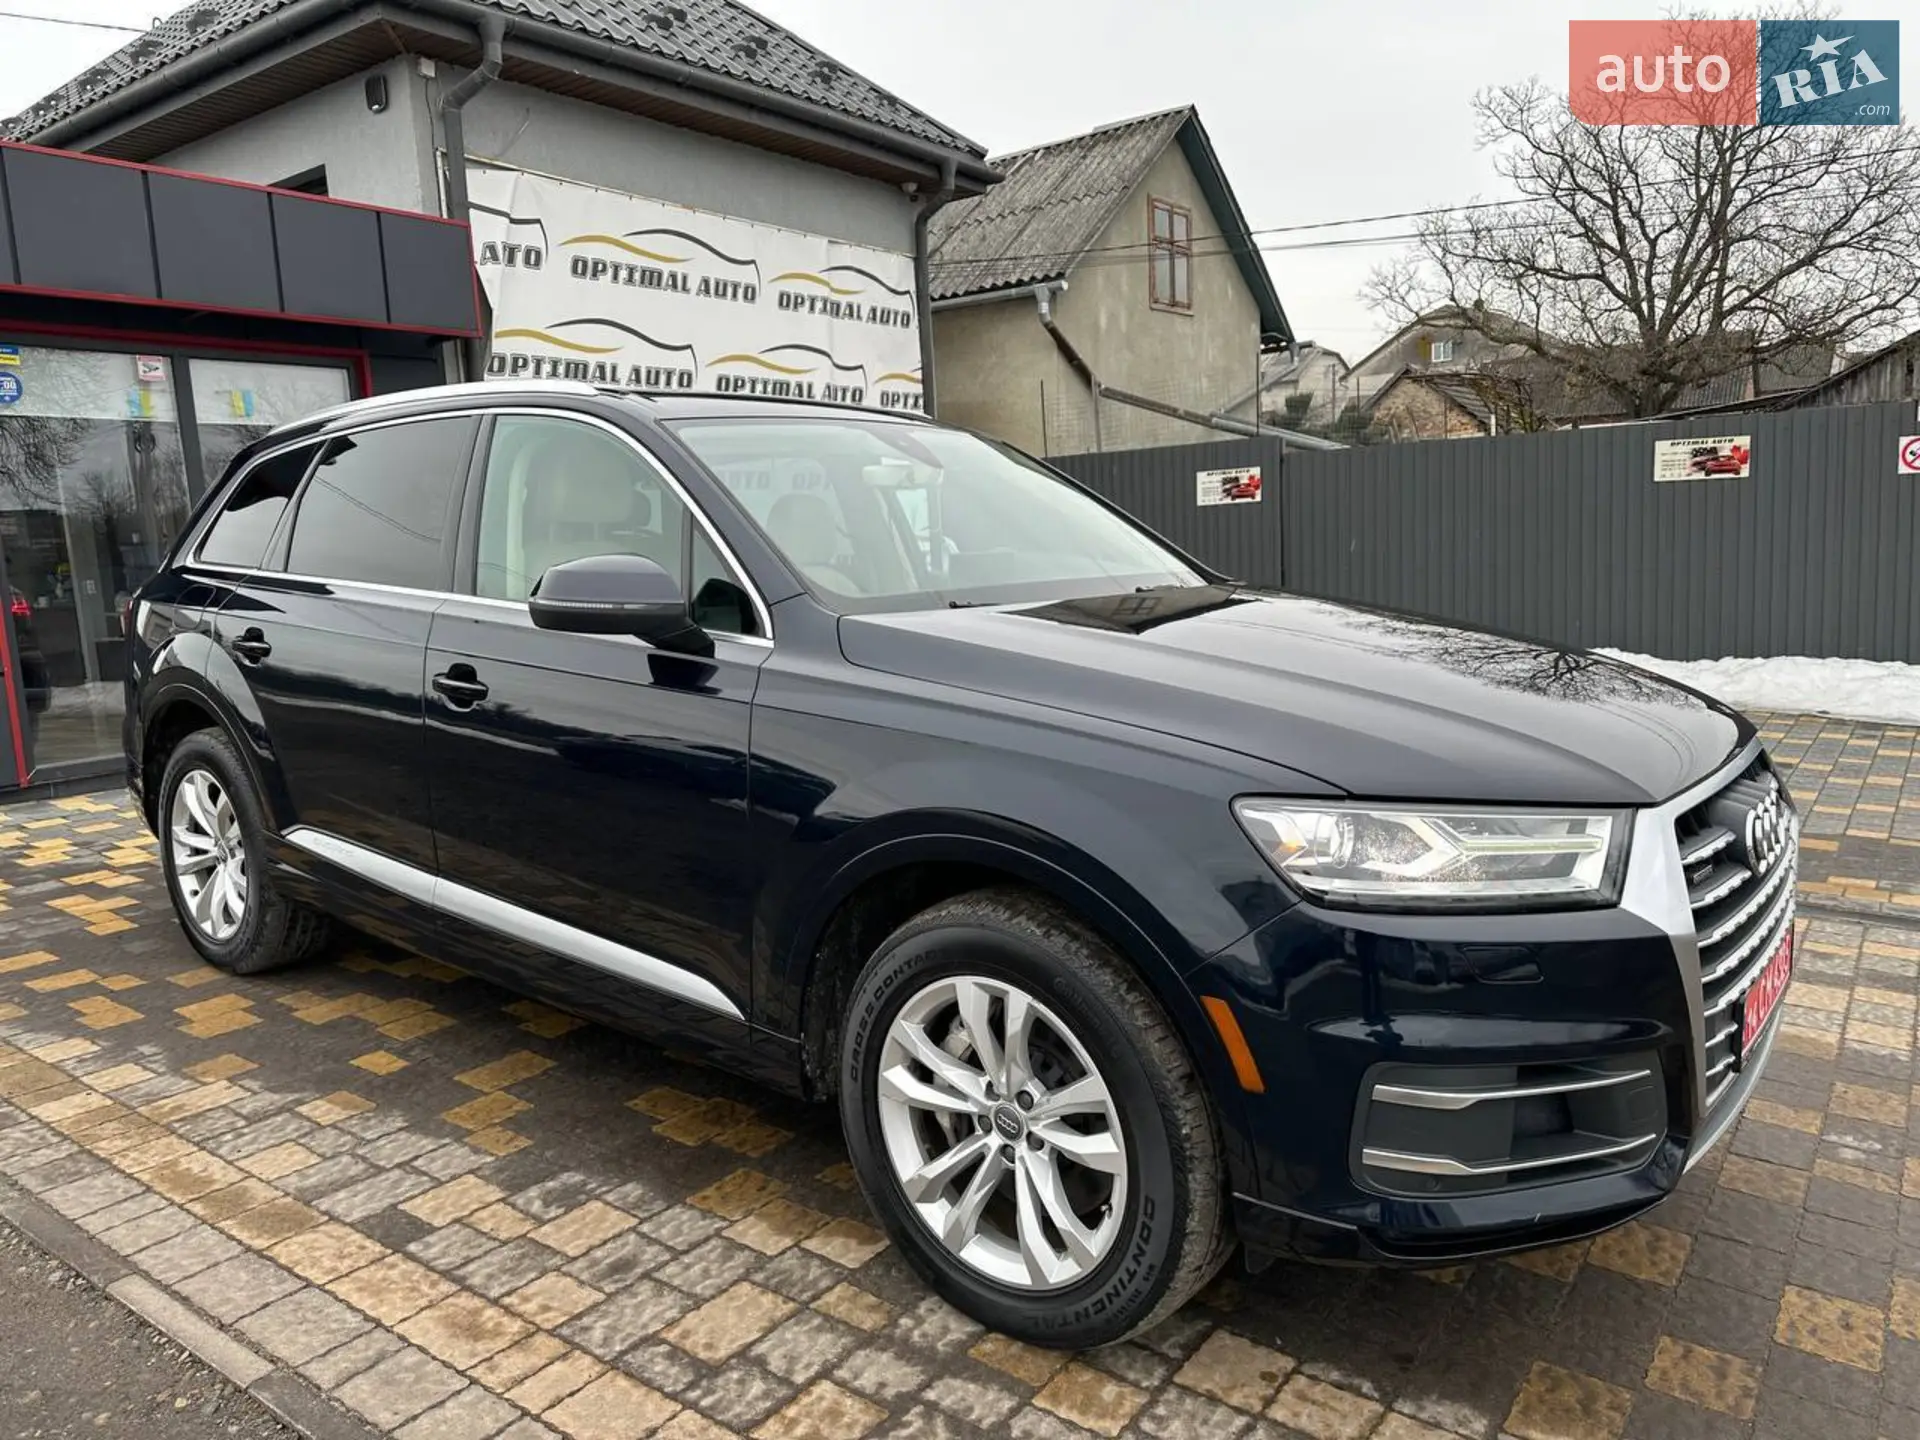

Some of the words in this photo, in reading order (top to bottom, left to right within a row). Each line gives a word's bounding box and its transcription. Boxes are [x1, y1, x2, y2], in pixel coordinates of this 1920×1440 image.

[570, 254, 691, 295] OPTIMAL
[696, 275, 757, 304] AUTO
[866, 305, 911, 329] AUTO
[486, 352, 622, 384] OPTIMAL
[625, 364, 693, 388] AUTO
[716, 374, 815, 400] OPTIMAL
